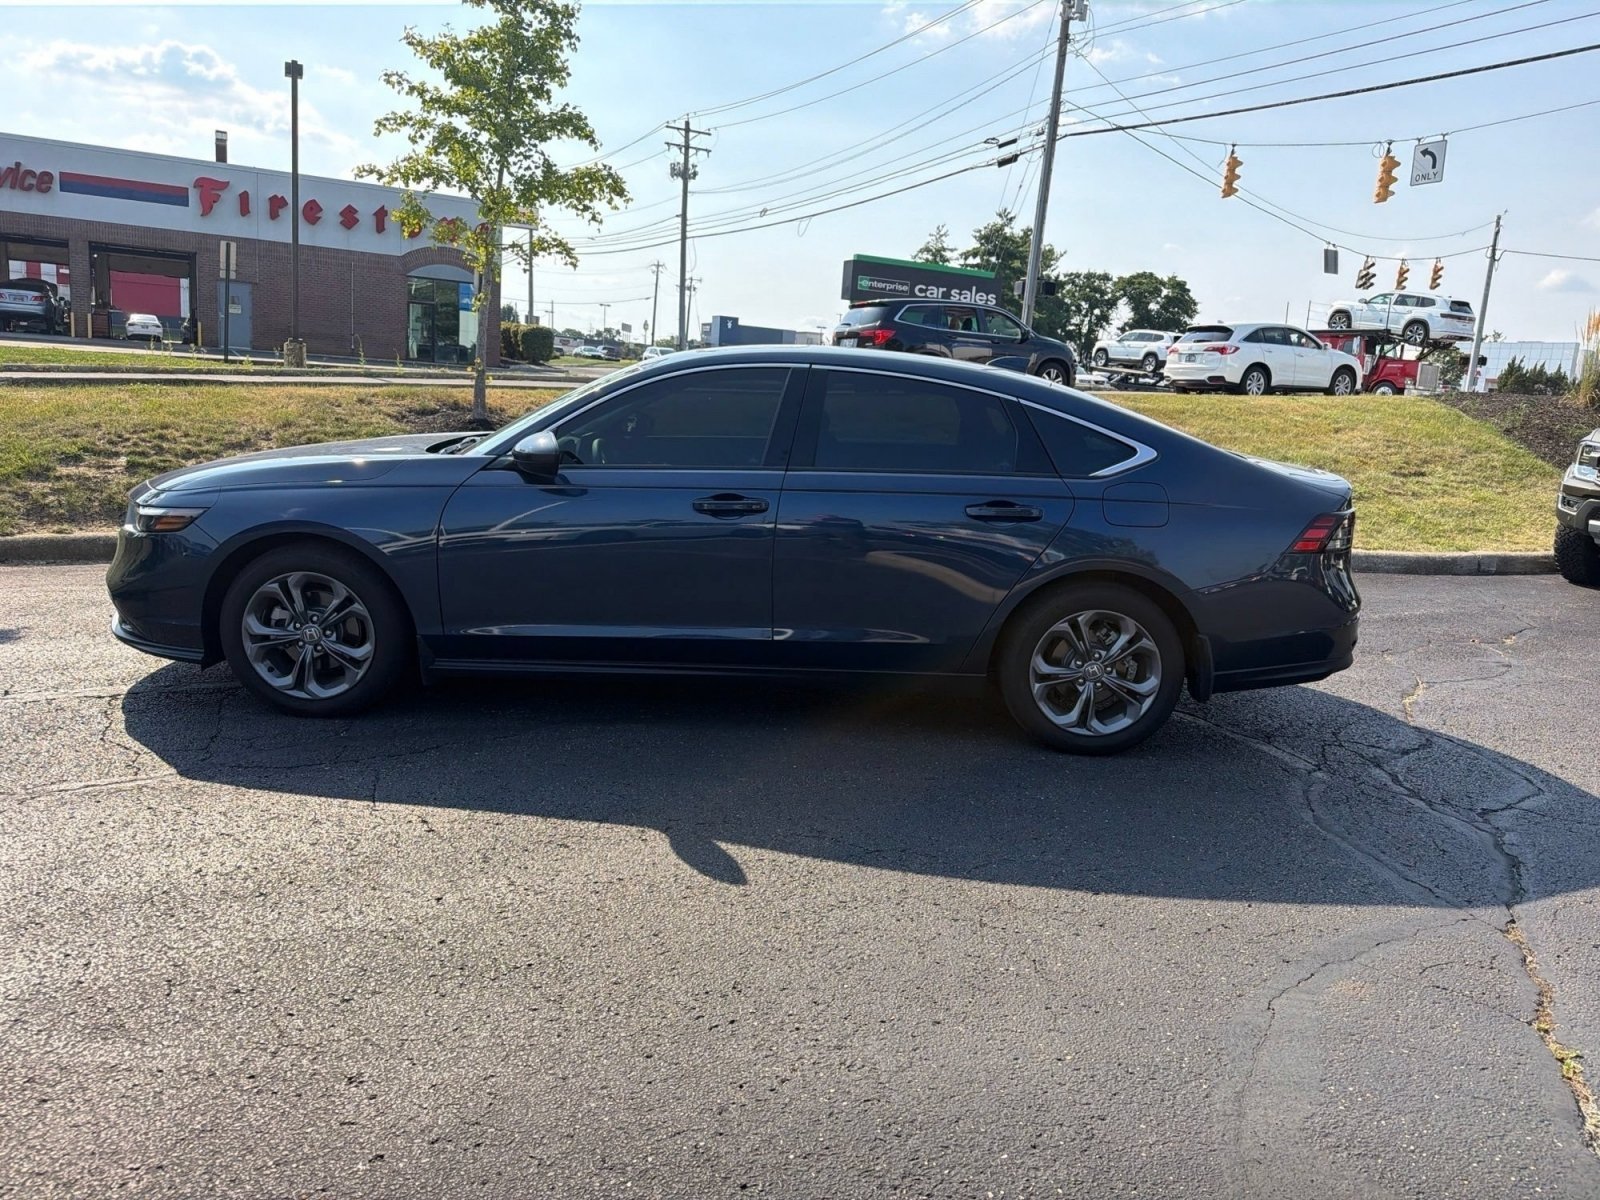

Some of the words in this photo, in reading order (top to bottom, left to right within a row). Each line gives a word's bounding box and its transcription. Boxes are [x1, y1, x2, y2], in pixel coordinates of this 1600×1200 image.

[1415, 171, 1438, 182] ONLY
[860, 279, 909, 292] enterprise
[914, 284, 946, 299] car
[950, 286, 997, 306] sales
